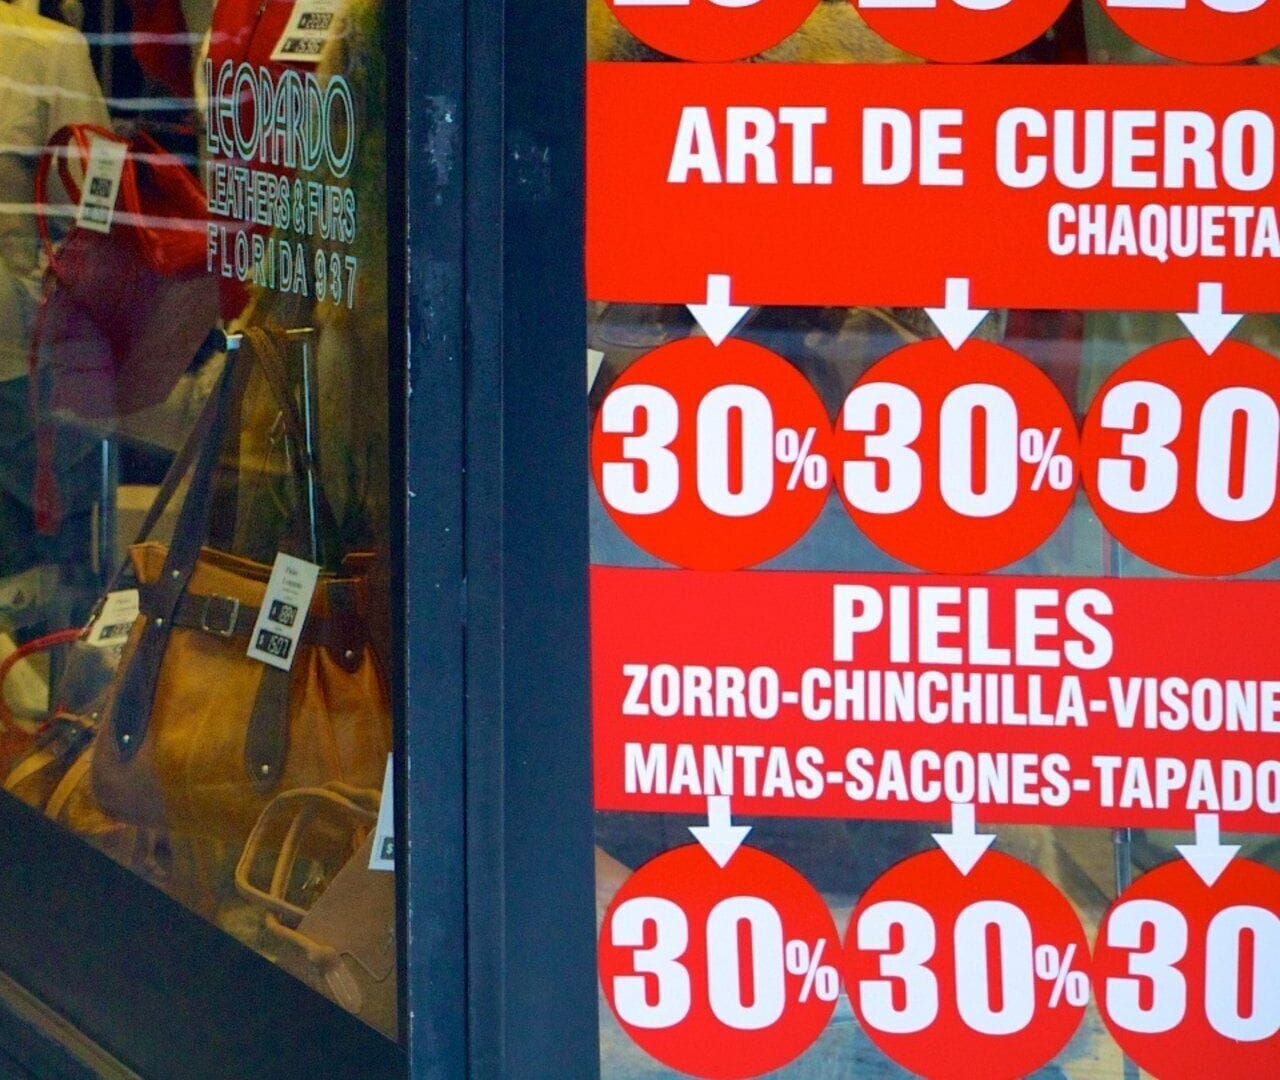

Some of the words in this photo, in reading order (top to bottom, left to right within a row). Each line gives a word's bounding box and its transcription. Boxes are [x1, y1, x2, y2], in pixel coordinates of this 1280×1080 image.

[205, 58, 355, 179] LEOPARDO
[666, 106, 833, 185] ART.
[861, 107, 964, 187] DE
[995, 107, 1275, 190] CUERO
[205, 160, 290, 230] LEATHERS
[292, 178, 306, 235] &
[306, 181, 357, 244] FURS
[1047, 202, 1280, 263] CHAQUETA
[206, 221, 308, 297] FLORIDA
[314, 247, 358, 310] 937
[601, 383, 828, 518] 30%
[842, 381, 1073, 519] 30%
[832, 583, 1114, 670] PIELES
[611, 895, 839, 1030] 30%
[856, 899, 1090, 1035] 30%
